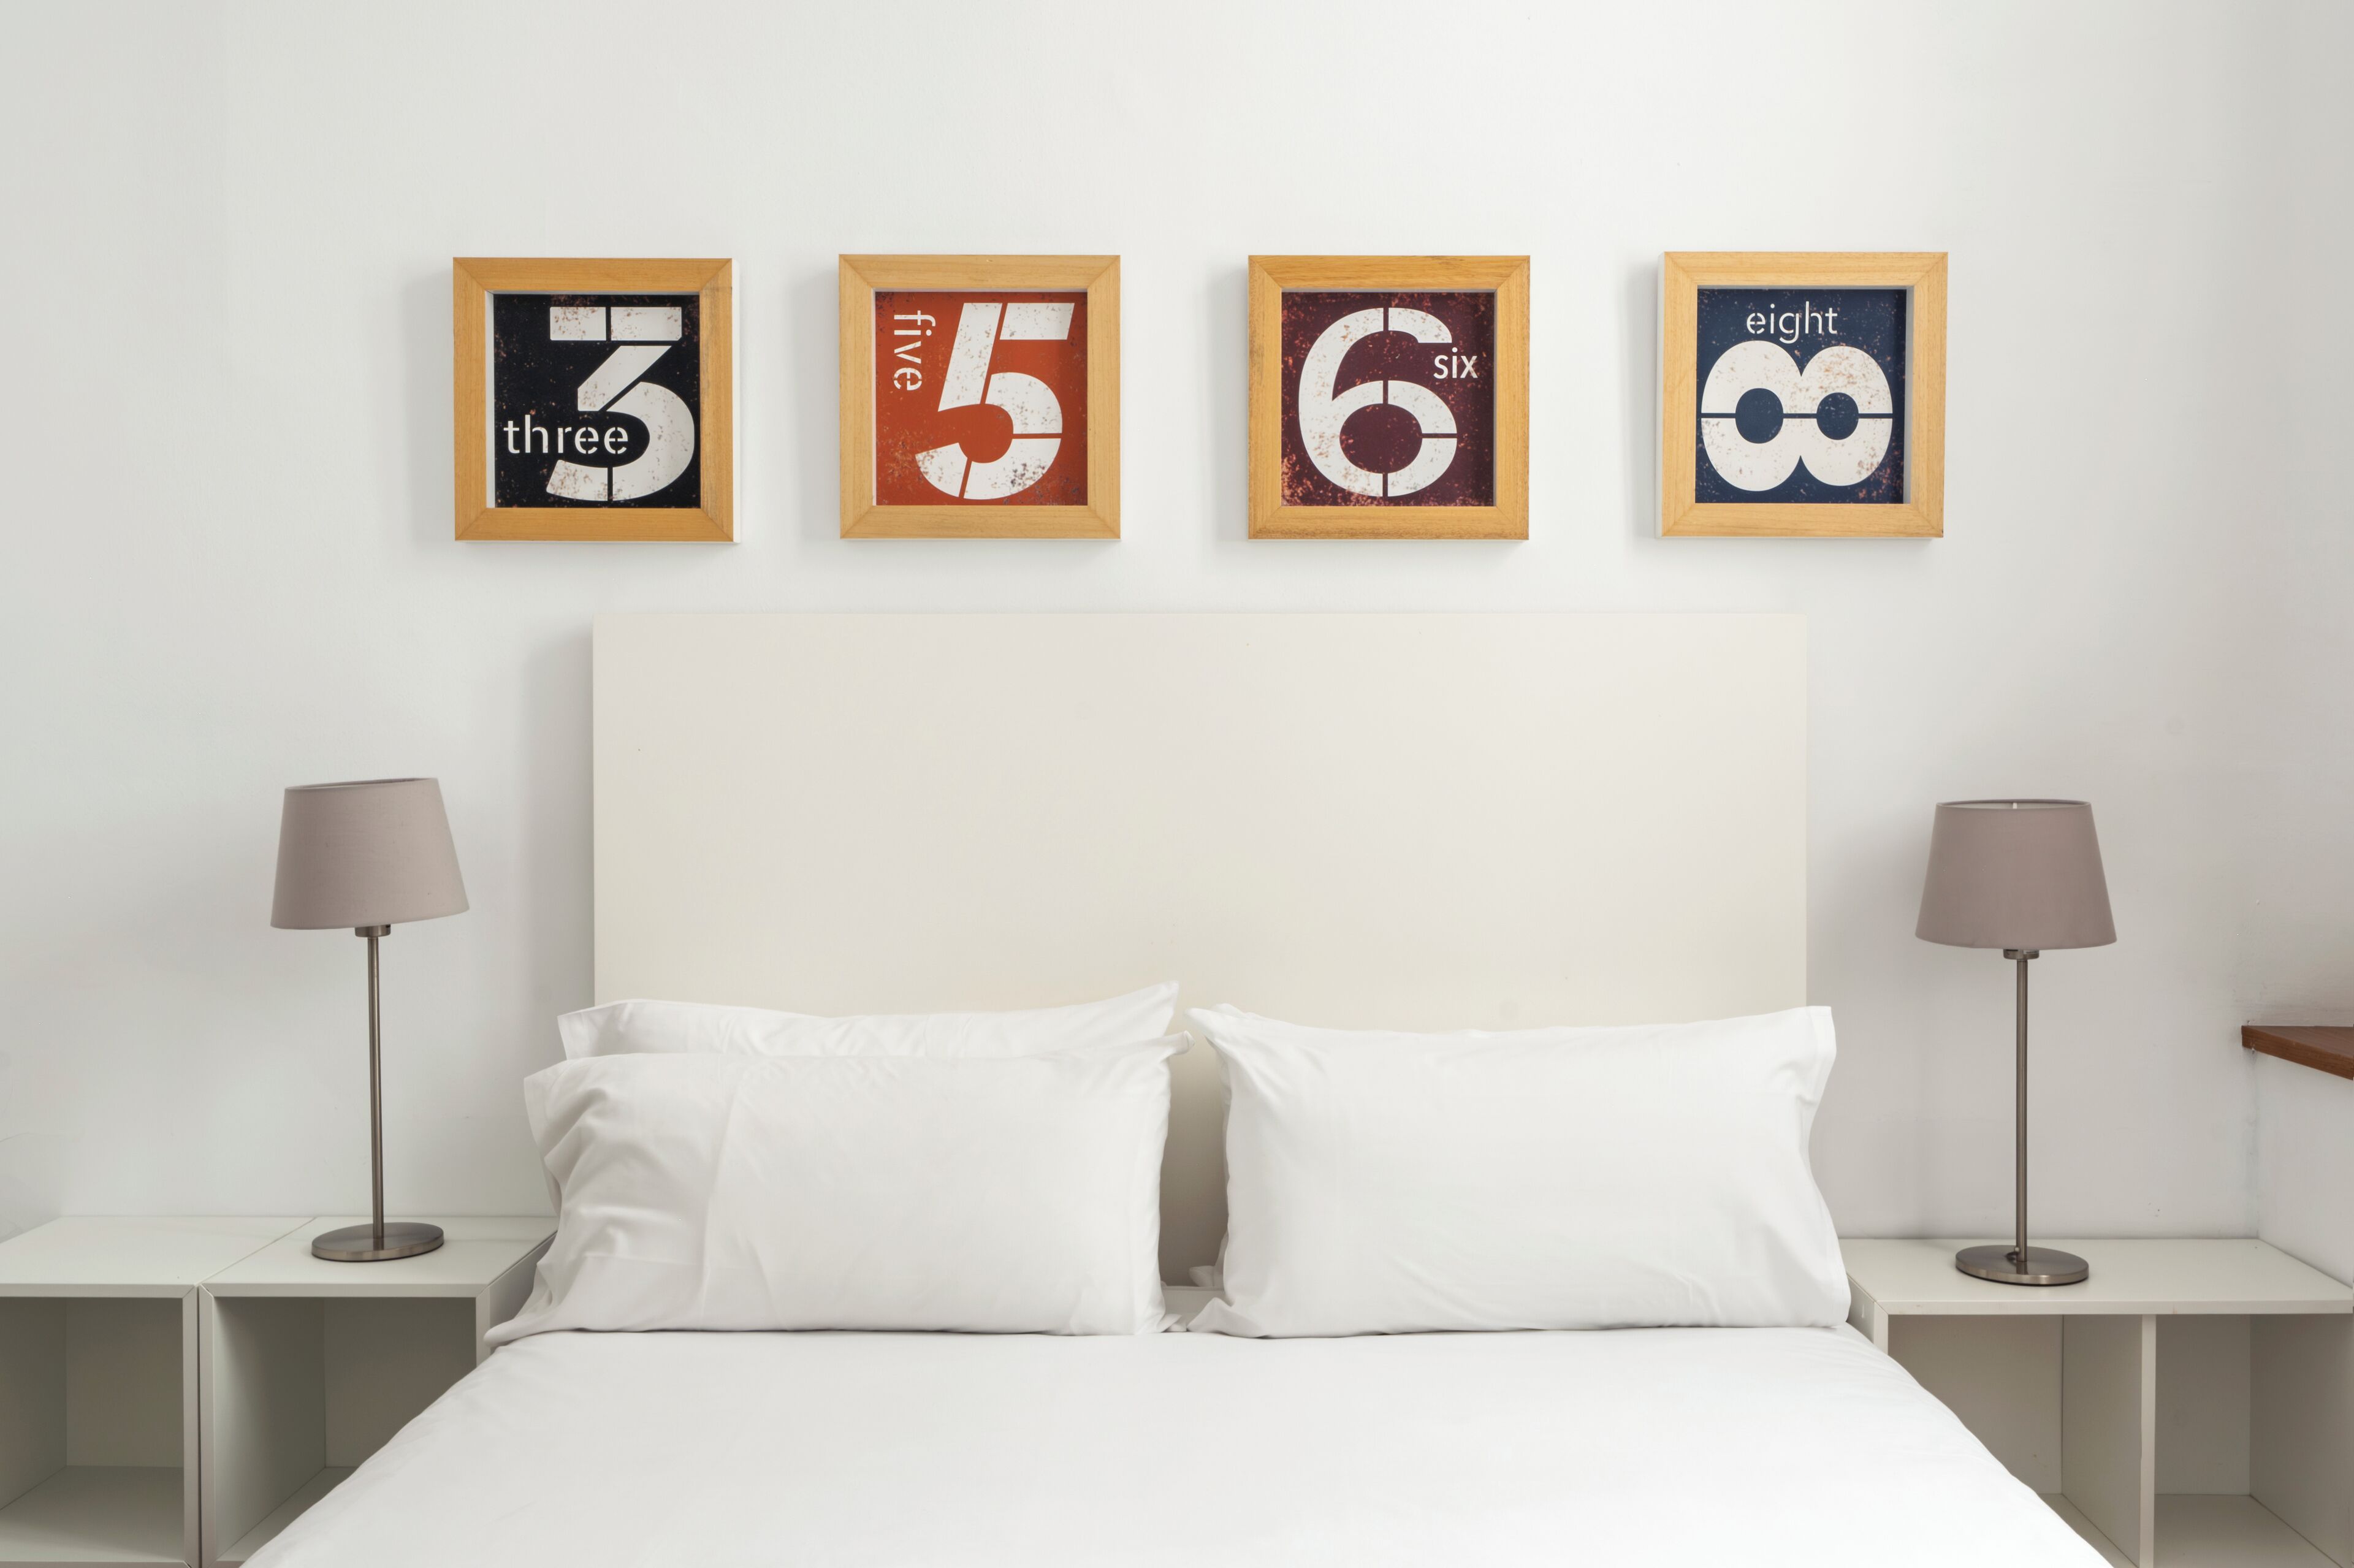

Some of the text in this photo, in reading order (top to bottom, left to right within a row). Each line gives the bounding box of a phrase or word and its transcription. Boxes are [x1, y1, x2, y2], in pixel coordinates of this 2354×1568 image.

[893, 310, 936, 391] five
[1433, 347, 1479, 379] six
[1746, 301, 1838, 344] eight
[503, 414, 628, 454] three
[546, 306, 695, 501] 3
[915, 302, 1075, 500] 5
[1298, 307, 1458, 497] 6
[1701, 340, 1894, 492] 8
